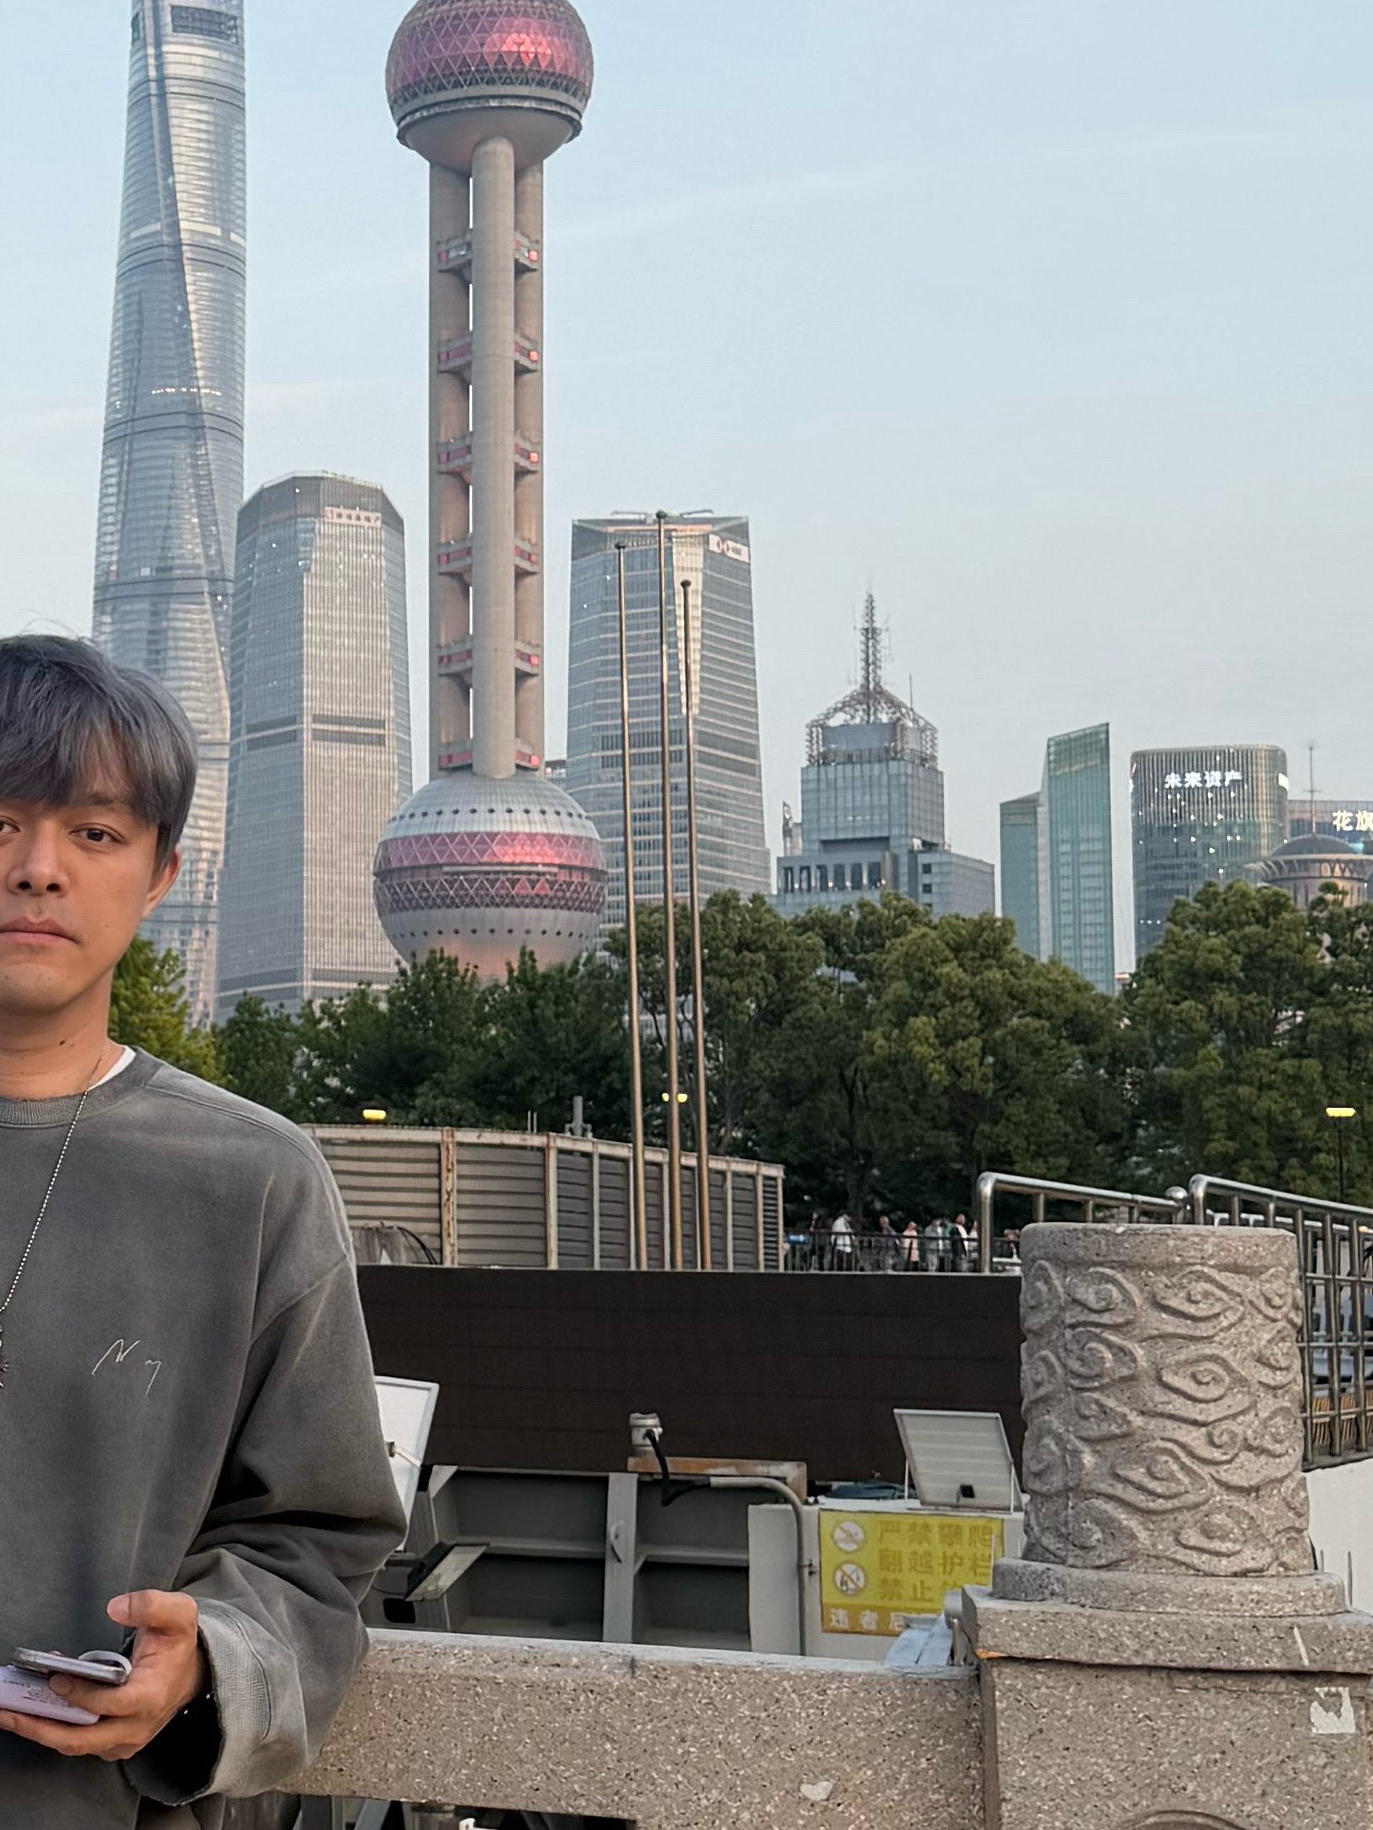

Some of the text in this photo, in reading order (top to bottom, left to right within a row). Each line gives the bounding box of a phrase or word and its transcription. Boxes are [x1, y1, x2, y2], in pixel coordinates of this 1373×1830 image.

[1164, 770, 1243, 789] 未来资产
[878, 1520, 994, 1548] 严禁攀爬
[878, 1548, 992, 1577] 翻越护栏
